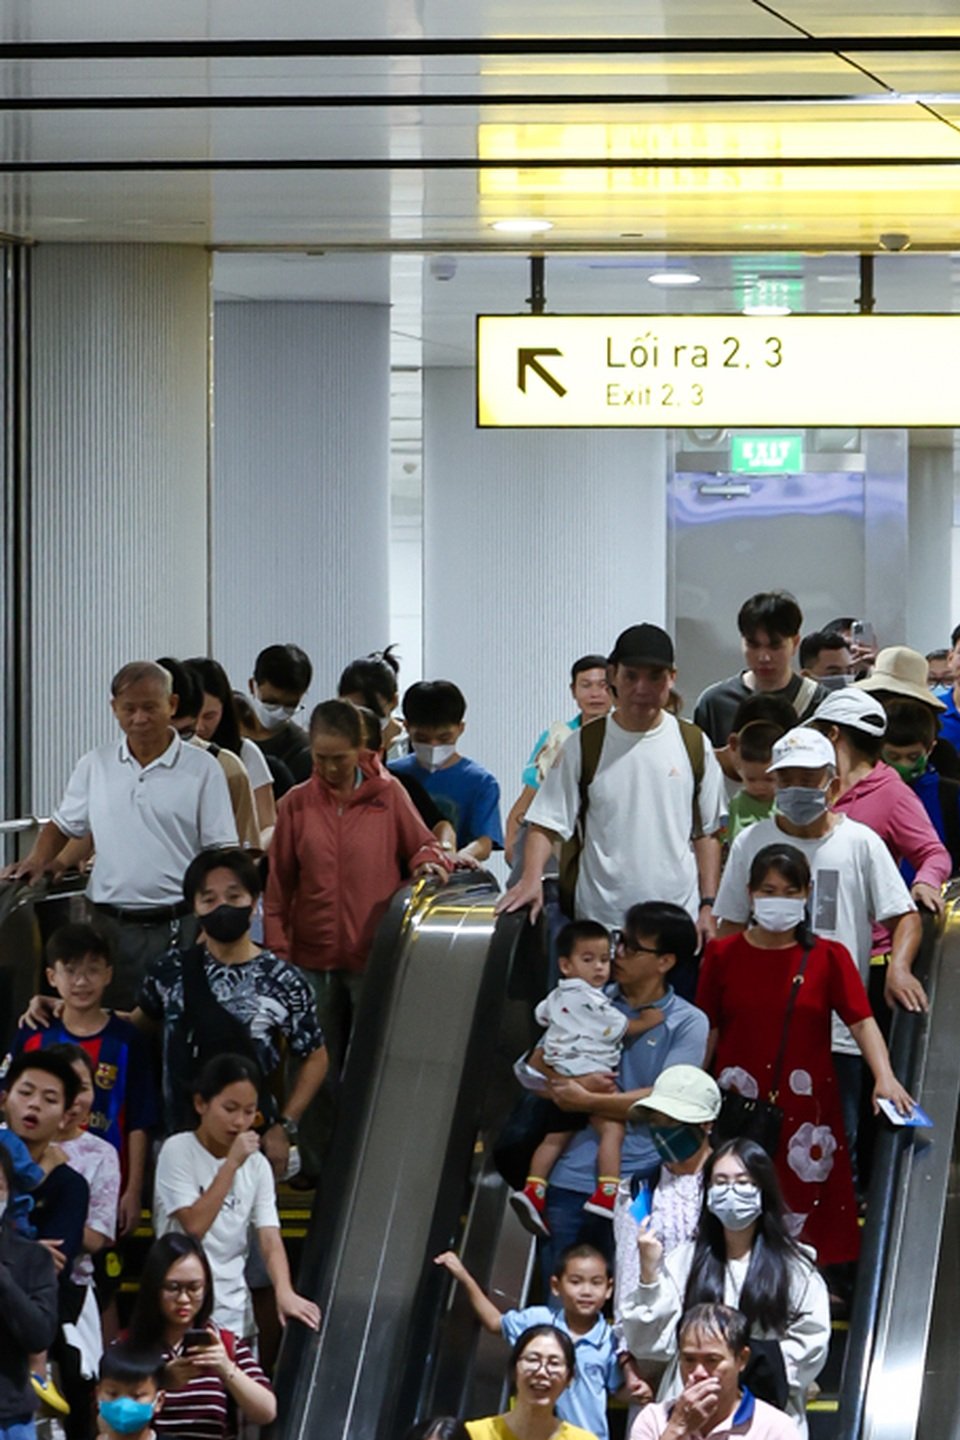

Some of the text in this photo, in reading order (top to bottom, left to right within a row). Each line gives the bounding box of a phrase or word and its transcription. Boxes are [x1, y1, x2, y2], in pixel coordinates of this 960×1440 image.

[606, 331, 658, 368] Lối
[674, 345, 708, 368] ra
[764, 336, 783, 368] 3
[606, 383, 652, 406] Exit
[691, 383, 704, 406] 3
[742, 440, 791, 459] EXIT
